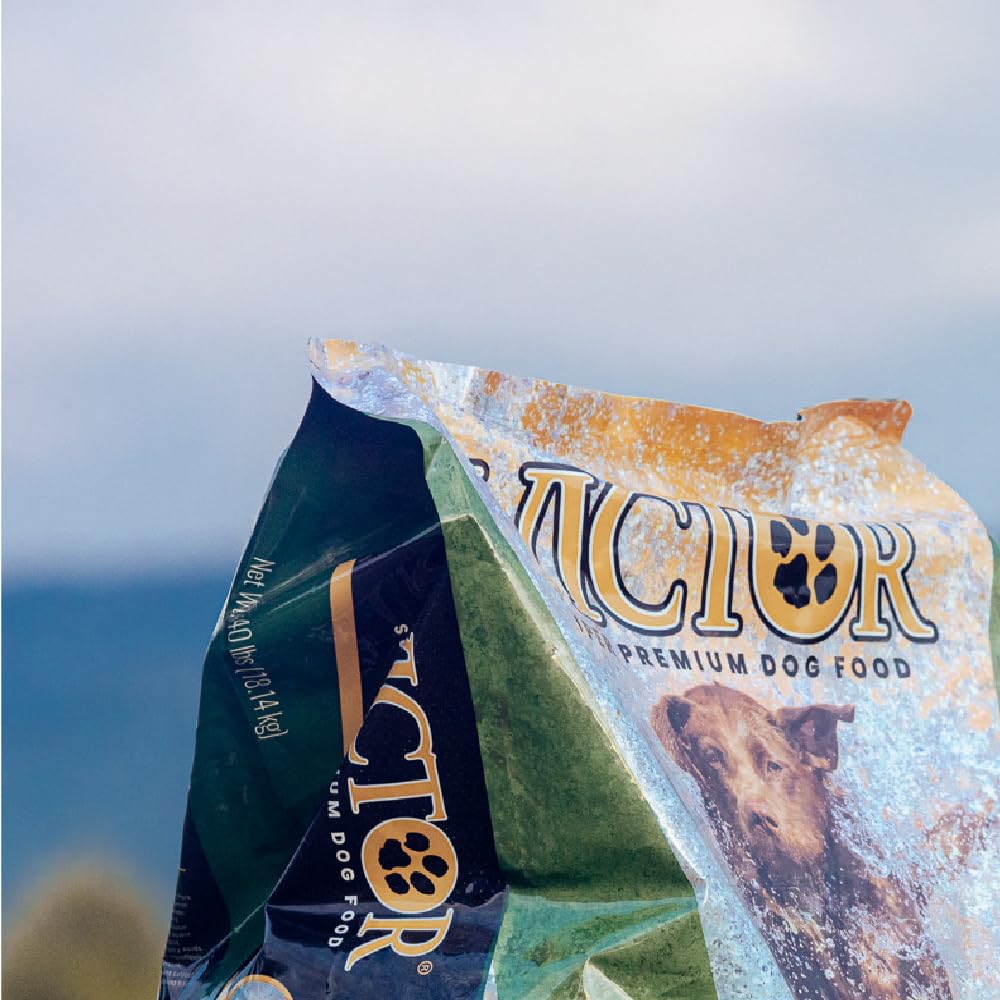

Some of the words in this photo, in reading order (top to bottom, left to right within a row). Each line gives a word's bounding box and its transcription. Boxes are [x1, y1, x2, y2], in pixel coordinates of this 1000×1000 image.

[244, 557, 276, 588] Net
[227, 620, 253, 642] 40
[229, 644, 257, 666] lbs
[617, 643, 748, 675] PREMIUM
[761, 653, 820, 679] DOG
[834, 655, 912, 679] FOOD
[235, 667, 280, 711] (18.14
[254, 711, 289, 739] kg)
[331, 832, 355, 881] DOG
[328, 895, 358, 947] FOOD
